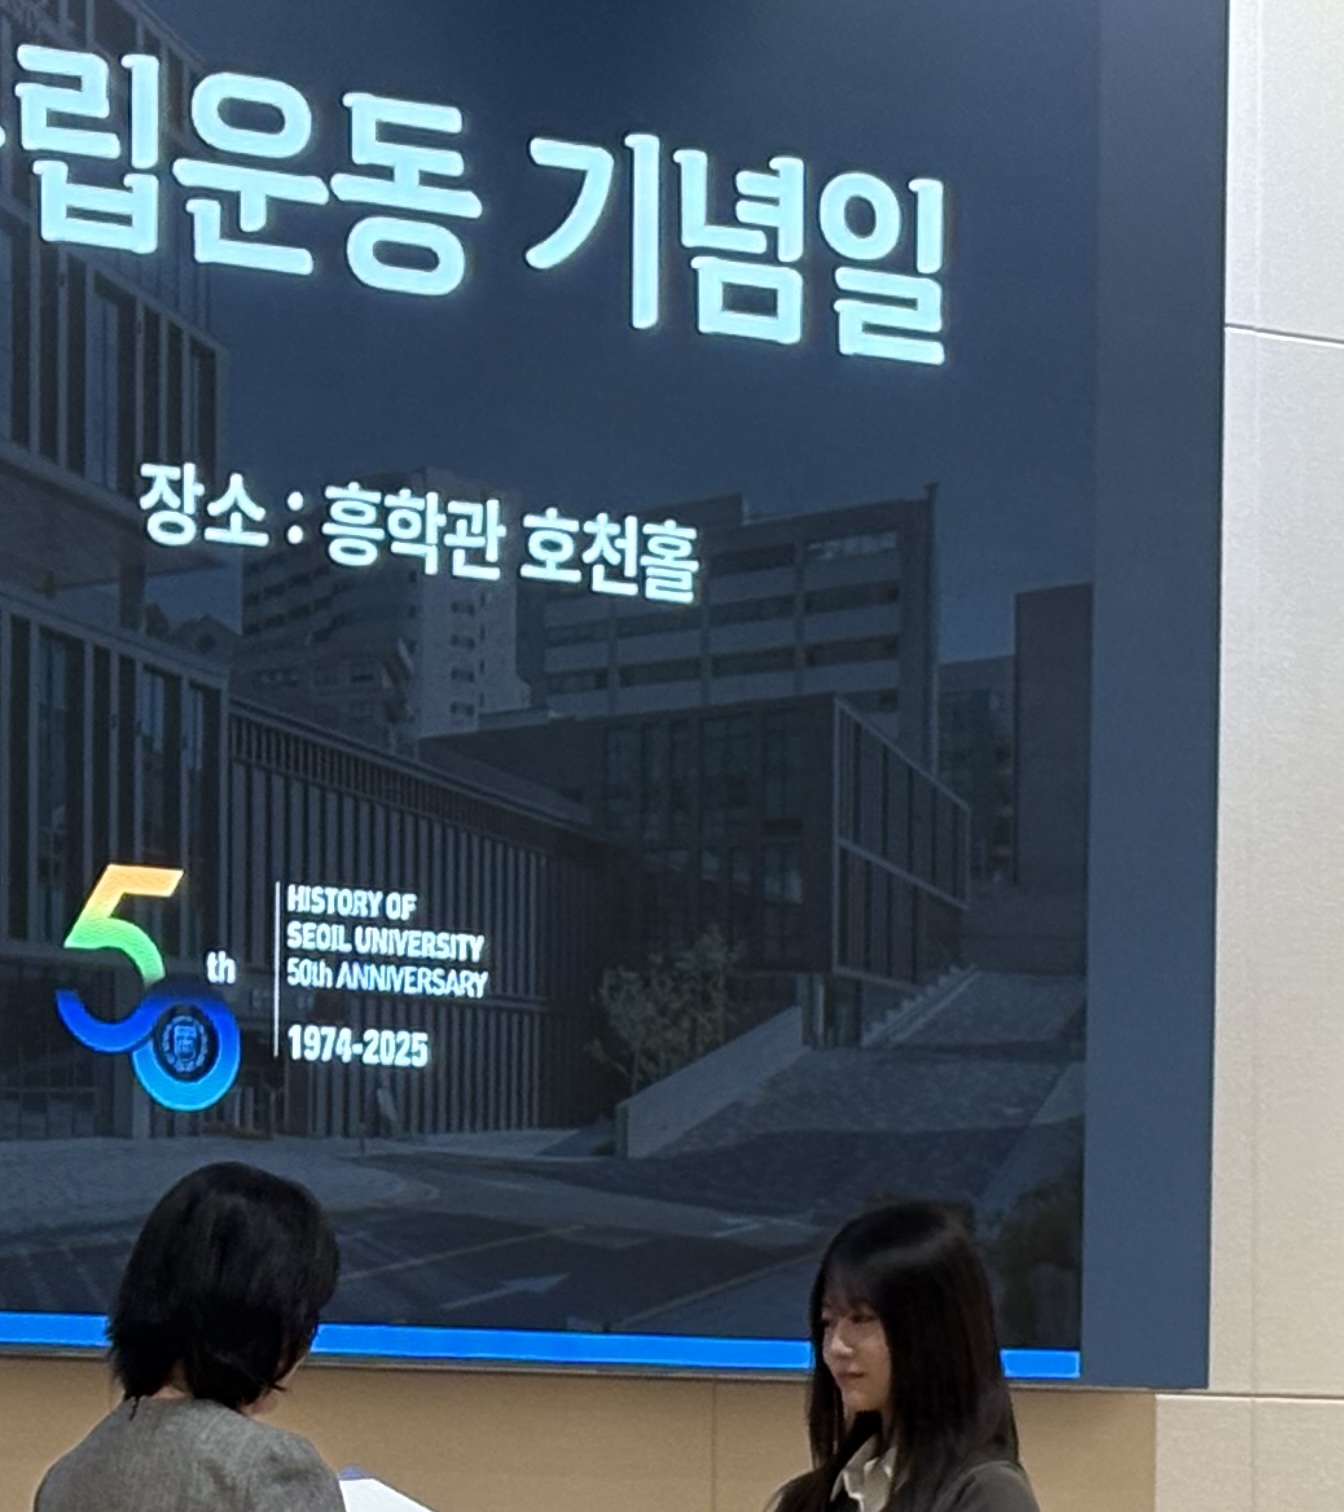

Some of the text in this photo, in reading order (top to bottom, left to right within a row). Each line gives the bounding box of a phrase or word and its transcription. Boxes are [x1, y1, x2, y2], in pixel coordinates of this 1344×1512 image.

[525, 133, 946, 366] 기념일
[139, 461, 270, 547] 장소
[321, 481, 508, 582] 흥학관
[520, 507, 700, 605] 호천홀
[287, 883, 418, 921] HISTORY OF
[286, 920, 485, 963] SEOIL UNIVERSITY
[286, 956, 489, 999] 50th ANNIVERSARY
[287, 1024, 429, 1068] 1974-2025
